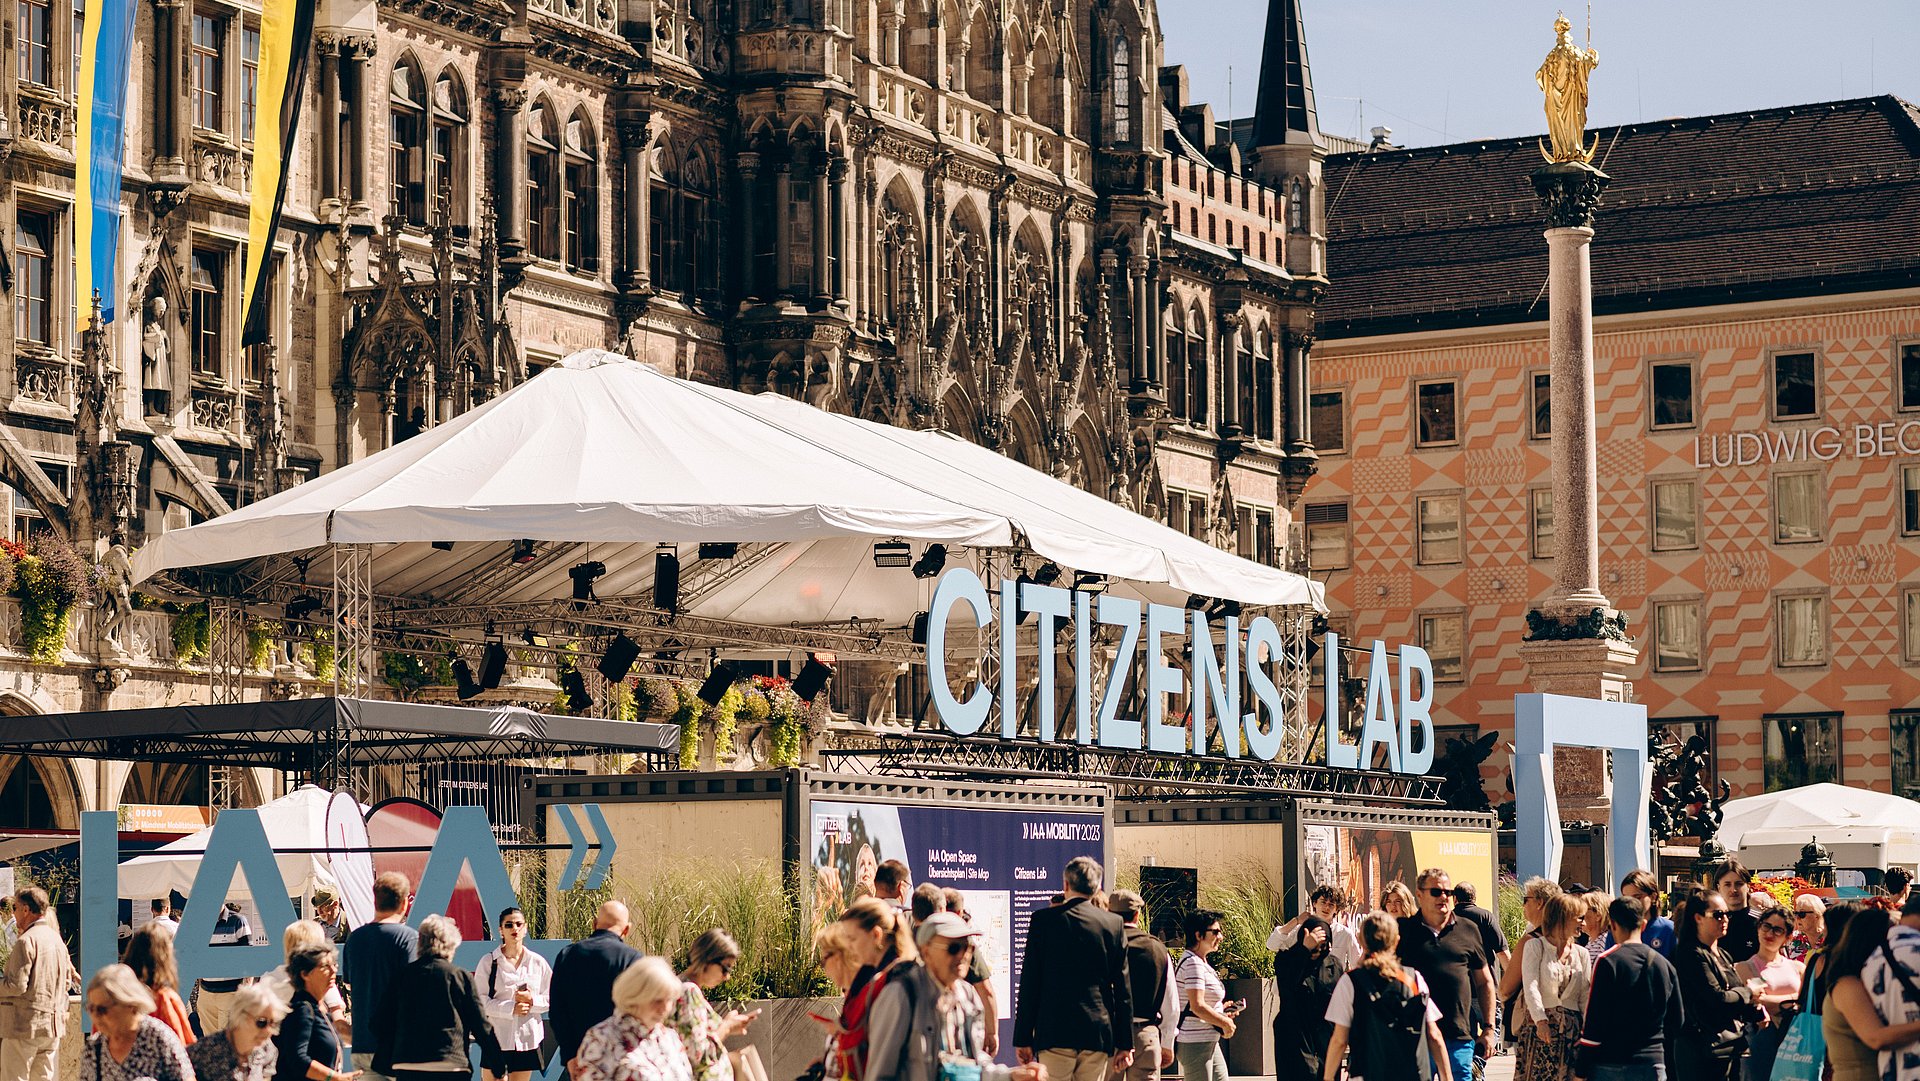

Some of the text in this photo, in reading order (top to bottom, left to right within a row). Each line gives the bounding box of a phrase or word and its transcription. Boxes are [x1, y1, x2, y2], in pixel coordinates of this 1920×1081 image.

[1694, 427, 1843, 469] LUDWIG
[926, 567, 1435, 776] CITIZENS LAB
[438, 780, 488, 790] JETZT IM CITIZENS LAB
[818, 818, 845, 831] CITIZENS
[1030, 822, 1100, 841] IAA MOBILITY 2023
[838, 832, 852, 844] LAB
[928, 849, 977, 866] IAA Open Space
[928, 865, 990, 881] Übersichtsplan Site Map
[1014, 866, 1047, 880] Citizens Lab
